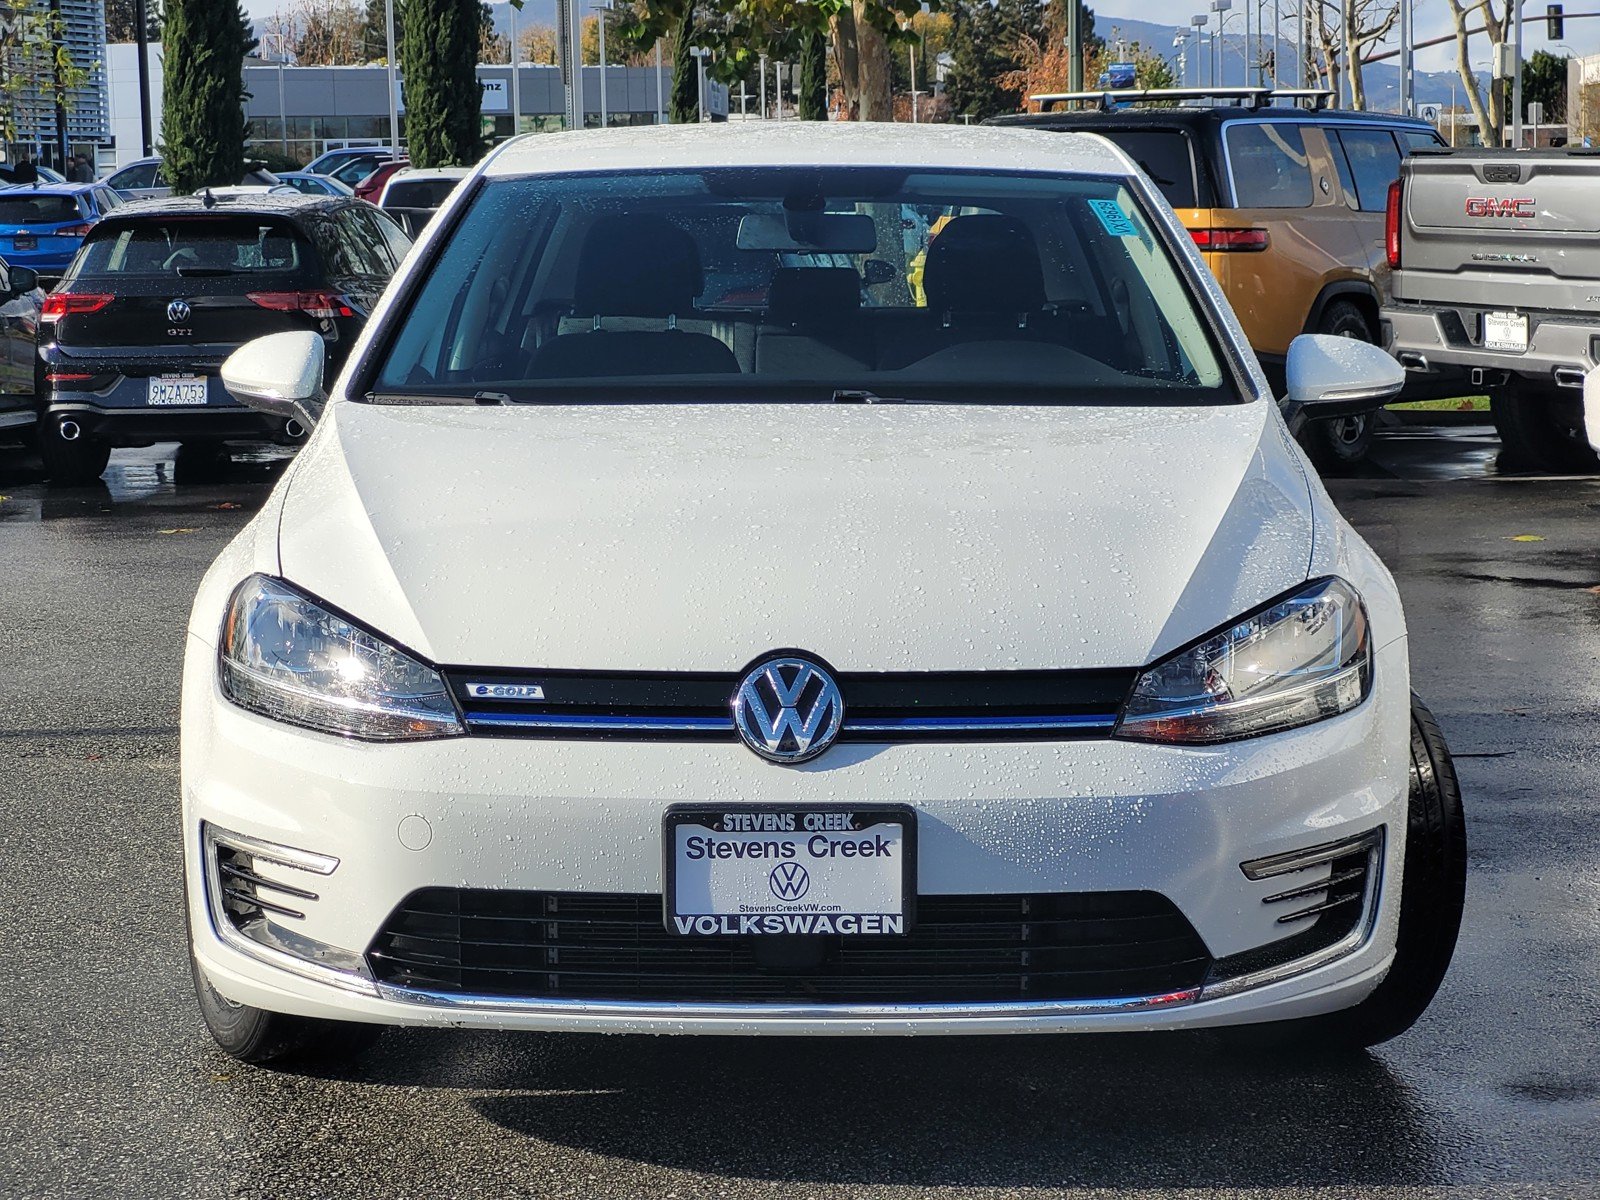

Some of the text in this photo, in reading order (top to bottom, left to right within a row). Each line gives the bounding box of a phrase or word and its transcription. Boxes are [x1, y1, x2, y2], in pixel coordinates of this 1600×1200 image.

[1465, 197, 1536, 218] GMC
[167, 328, 193, 336] GTI
[152, 384, 205, 400] 9MZA753
[723, 812, 855, 832] STEVENS CREEK
[685, 834, 892, 860] Stevens Creek
[738, 903, 842, 914] StevensCreekVW.com
[673, 914, 904, 935] VOLKSWAGEN
